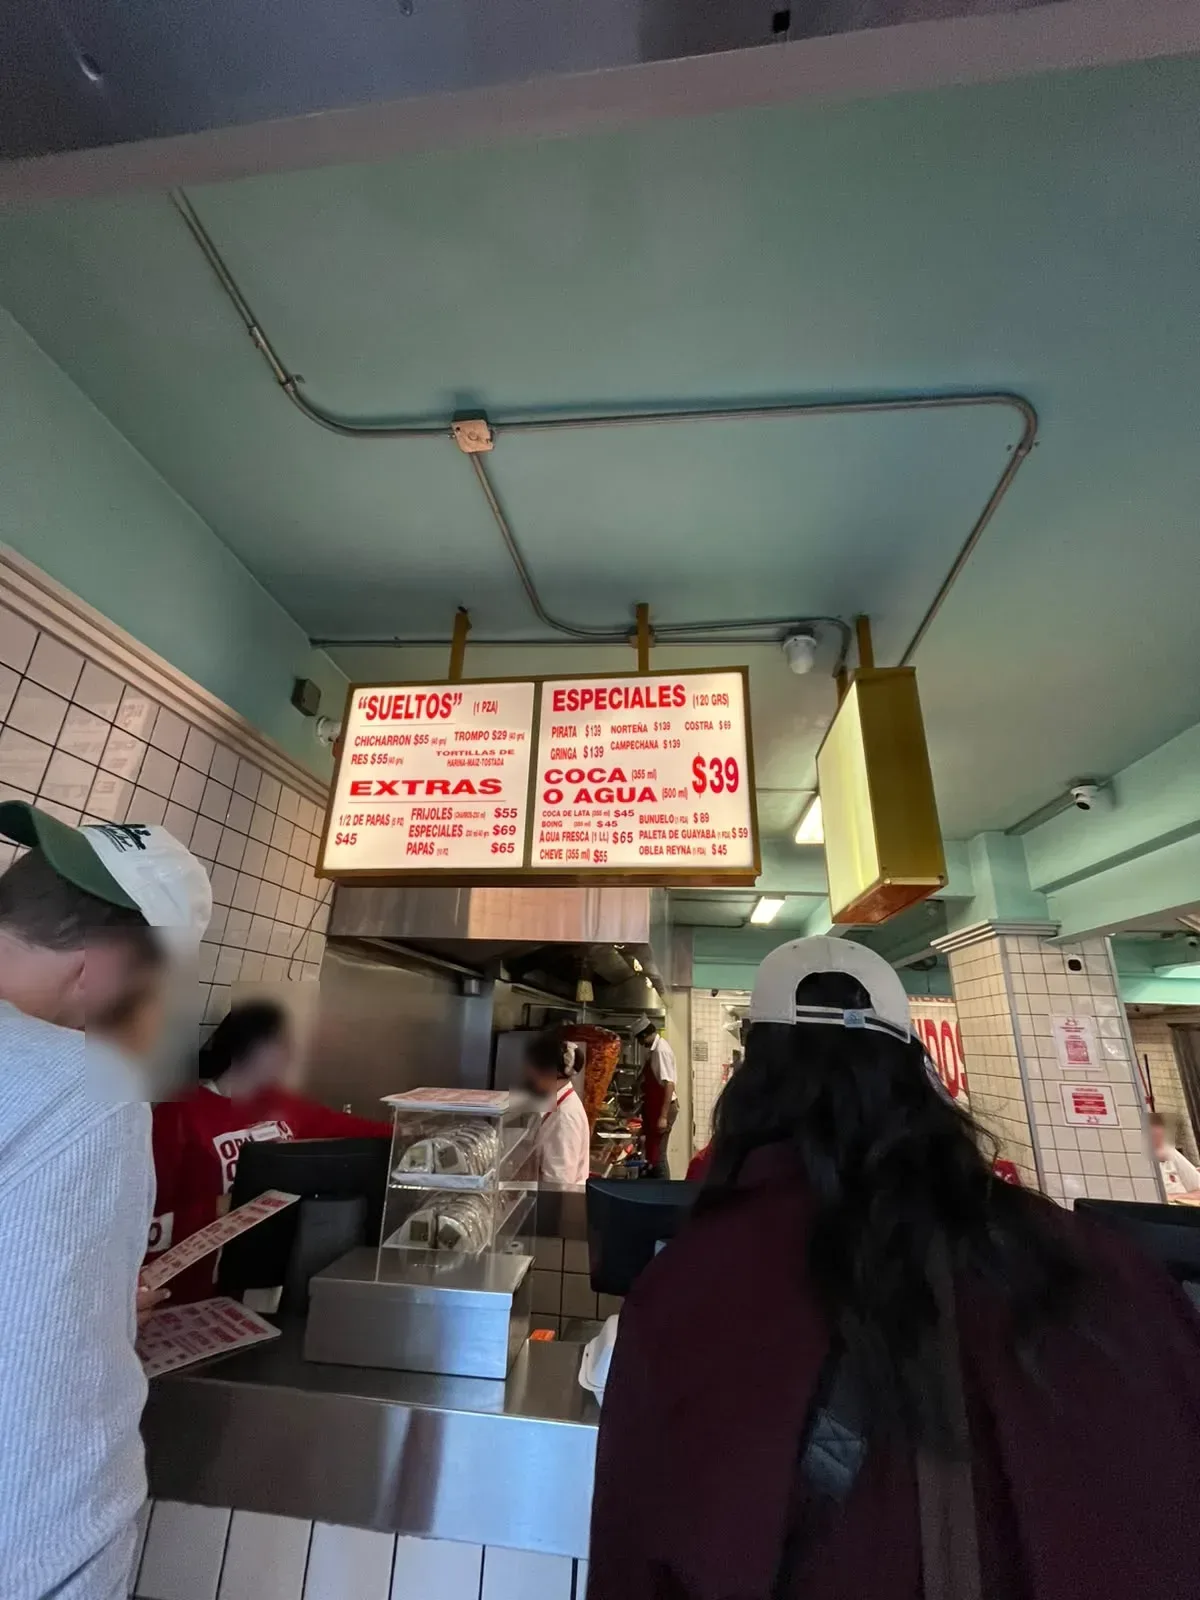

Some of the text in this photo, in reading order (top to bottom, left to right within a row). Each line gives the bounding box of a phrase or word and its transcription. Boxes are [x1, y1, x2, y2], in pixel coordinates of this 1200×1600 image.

[552, 684, 729, 711] ESPECIALES (120 GRS)
[482, 700, 498, 714] PZA)
[552, 724, 601, 738] PIRATA $139
[611, 721, 670, 734] NORTEÑA $139
[685, 721, 713, 730] COSTRA
[354, 735, 411, 747] CHICHARRON
[413, 734, 429, 745] $55
[455, 731, 489, 741] TROMPO
[492, 730, 507, 741] $29
[610, 739, 680, 750] CAMPECHANA $139
[351, 754, 368, 765] RES
[370, 753, 387, 765] $55
[550, 746, 604, 760] GRINGA $139
[544, 768, 627, 784] COCA
[632, 769, 645, 782] (355
[692, 753, 739, 798] $39
[349, 778, 503, 796] EXTRAS
[543, 788, 563, 804] O
[573, 787, 657, 803] AGUA
[339, 814, 351, 826] 1/2
[353, 814, 364, 826] DE
[365, 814, 390, 826] PAPAS
[411, 807, 453, 820] FRIJOLES
[494, 808, 517, 818] $55
[694, 812, 709, 823] $89
[408, 825, 463, 838] ESPECIALES
[493, 825, 516, 836] $69
[562, 831, 589, 842] FRESCA
[612, 831, 633, 844] $65
[639, 830, 666, 839] PALETA
[669, 830, 679, 839] DE
[681, 829, 716, 839] GUAYABA
[335, 832, 357, 846] $45
[406, 842, 434, 855] PAPAS
[491, 843, 514, 853] $65
[639, 846, 663, 855] OBLEA
[666, 846, 691, 855] REYNA
[712, 844, 727, 855] $45
[540, 849, 562, 860] CHEVE
[593, 849, 607, 863] $55
